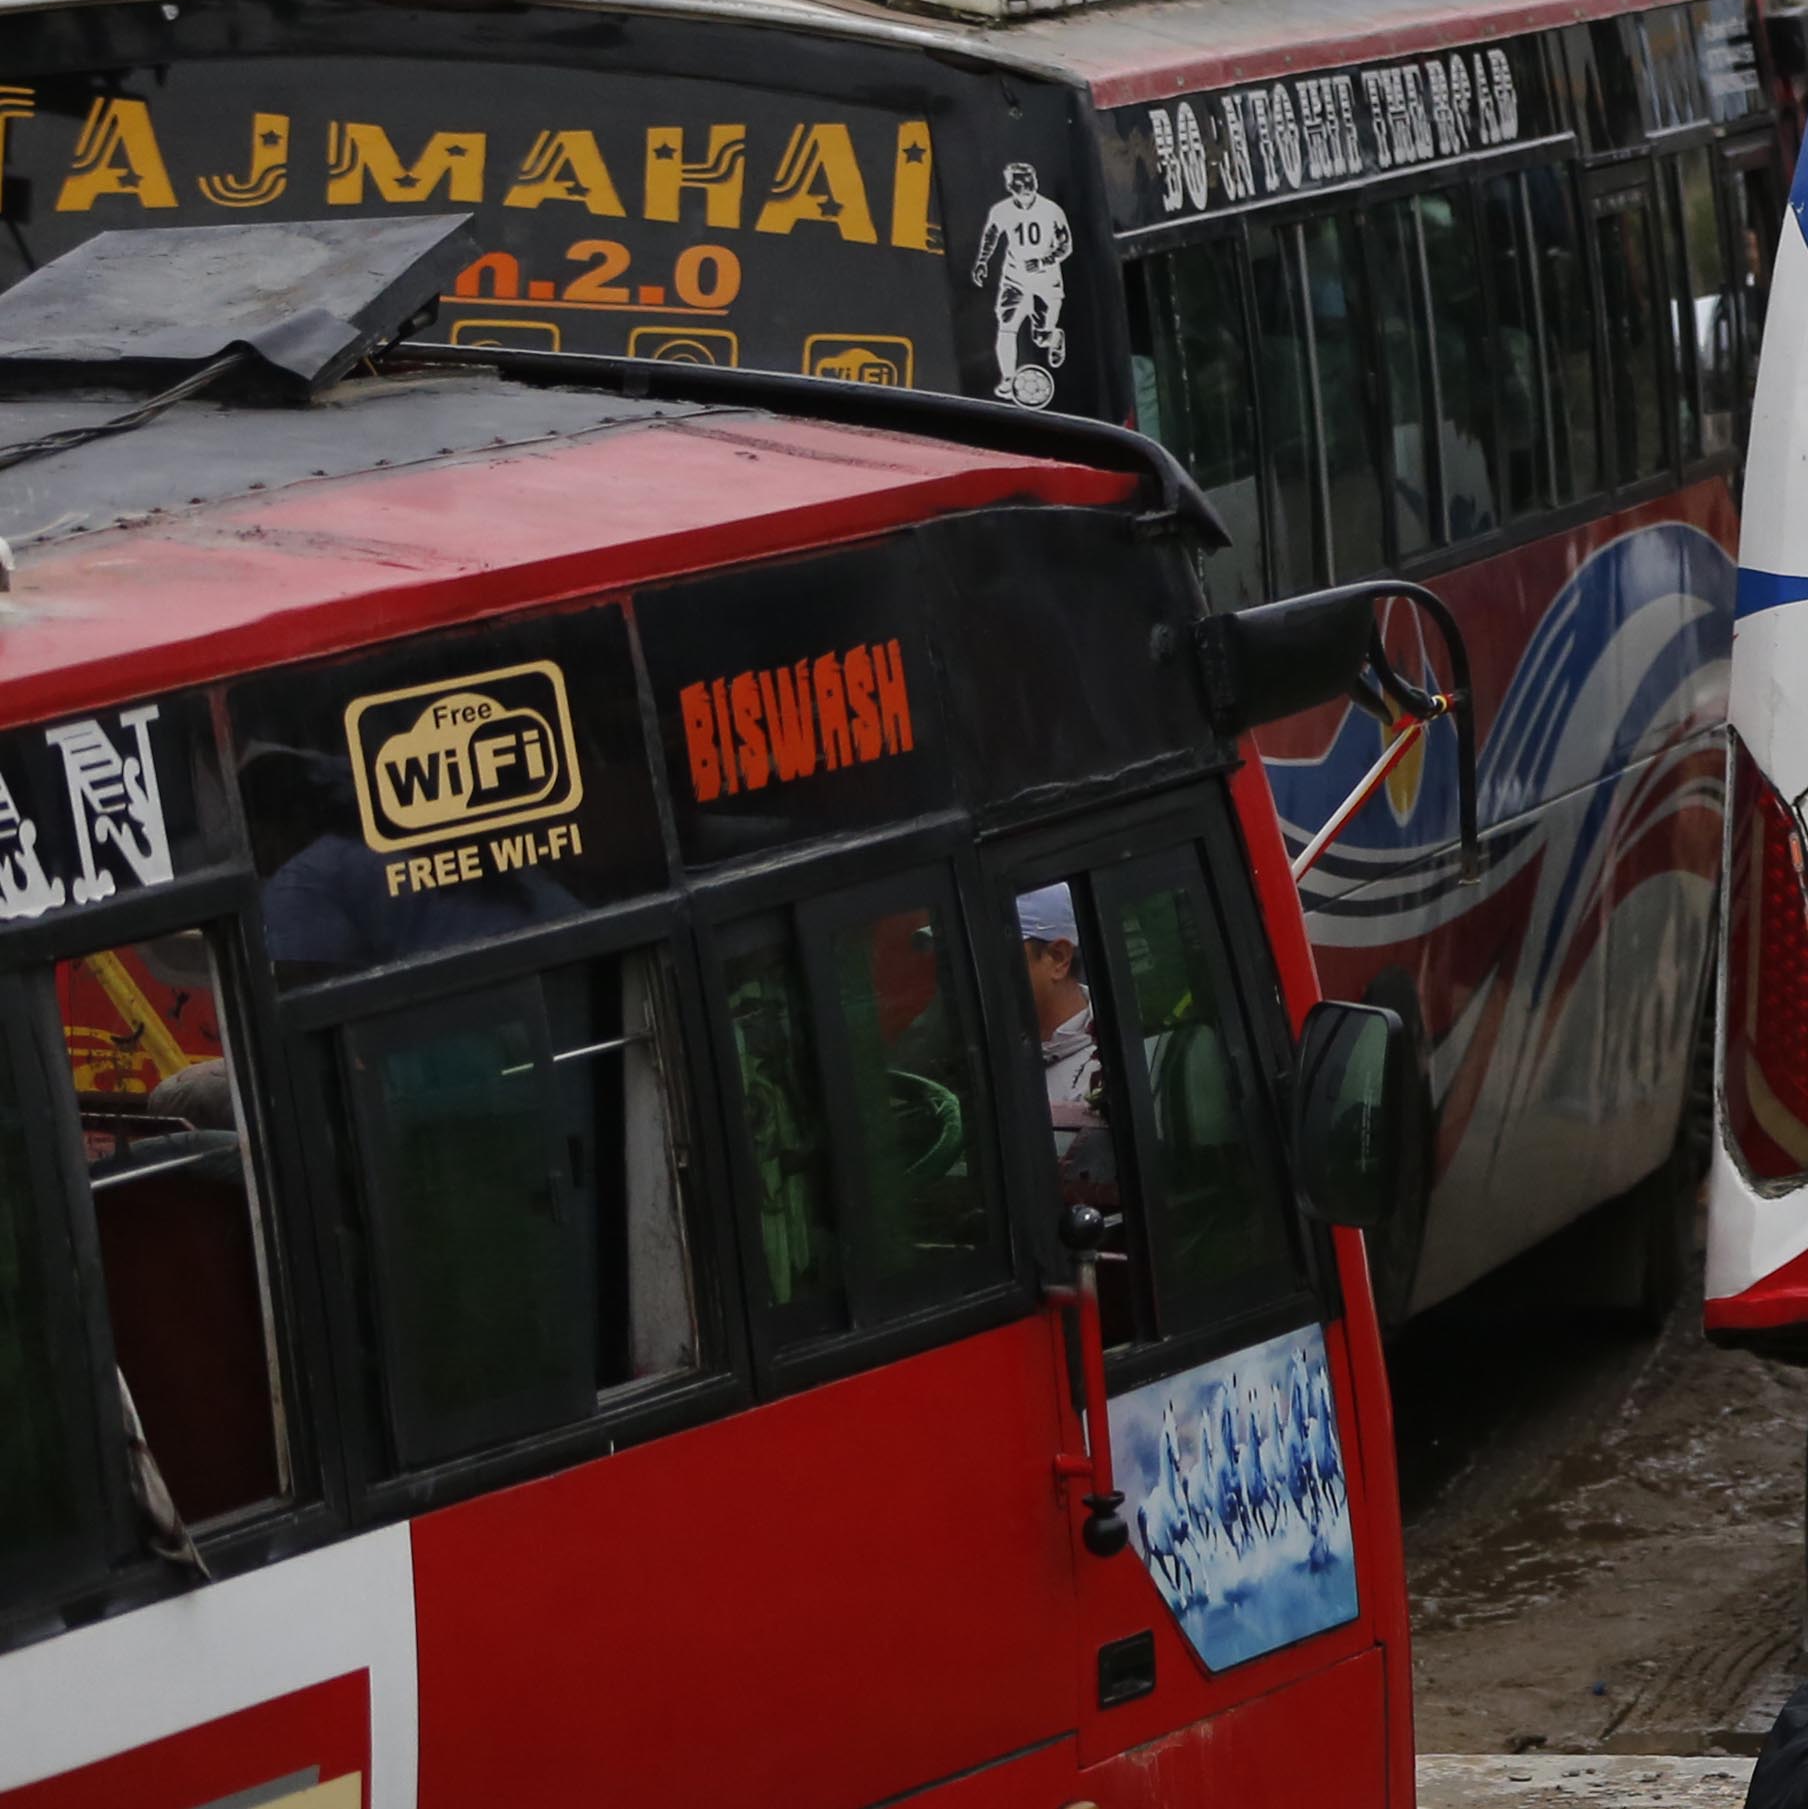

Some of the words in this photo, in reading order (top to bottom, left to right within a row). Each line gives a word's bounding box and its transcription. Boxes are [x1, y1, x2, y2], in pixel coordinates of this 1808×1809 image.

[1361, 64, 1435, 168] THE
[1014, 222, 1040, 246] 10
[432, 702, 493, 729] Free
[679, 638, 914, 803] BISWASH
[386, 846, 484, 897] FREE
[490, 823, 583, 873] WI-FI
